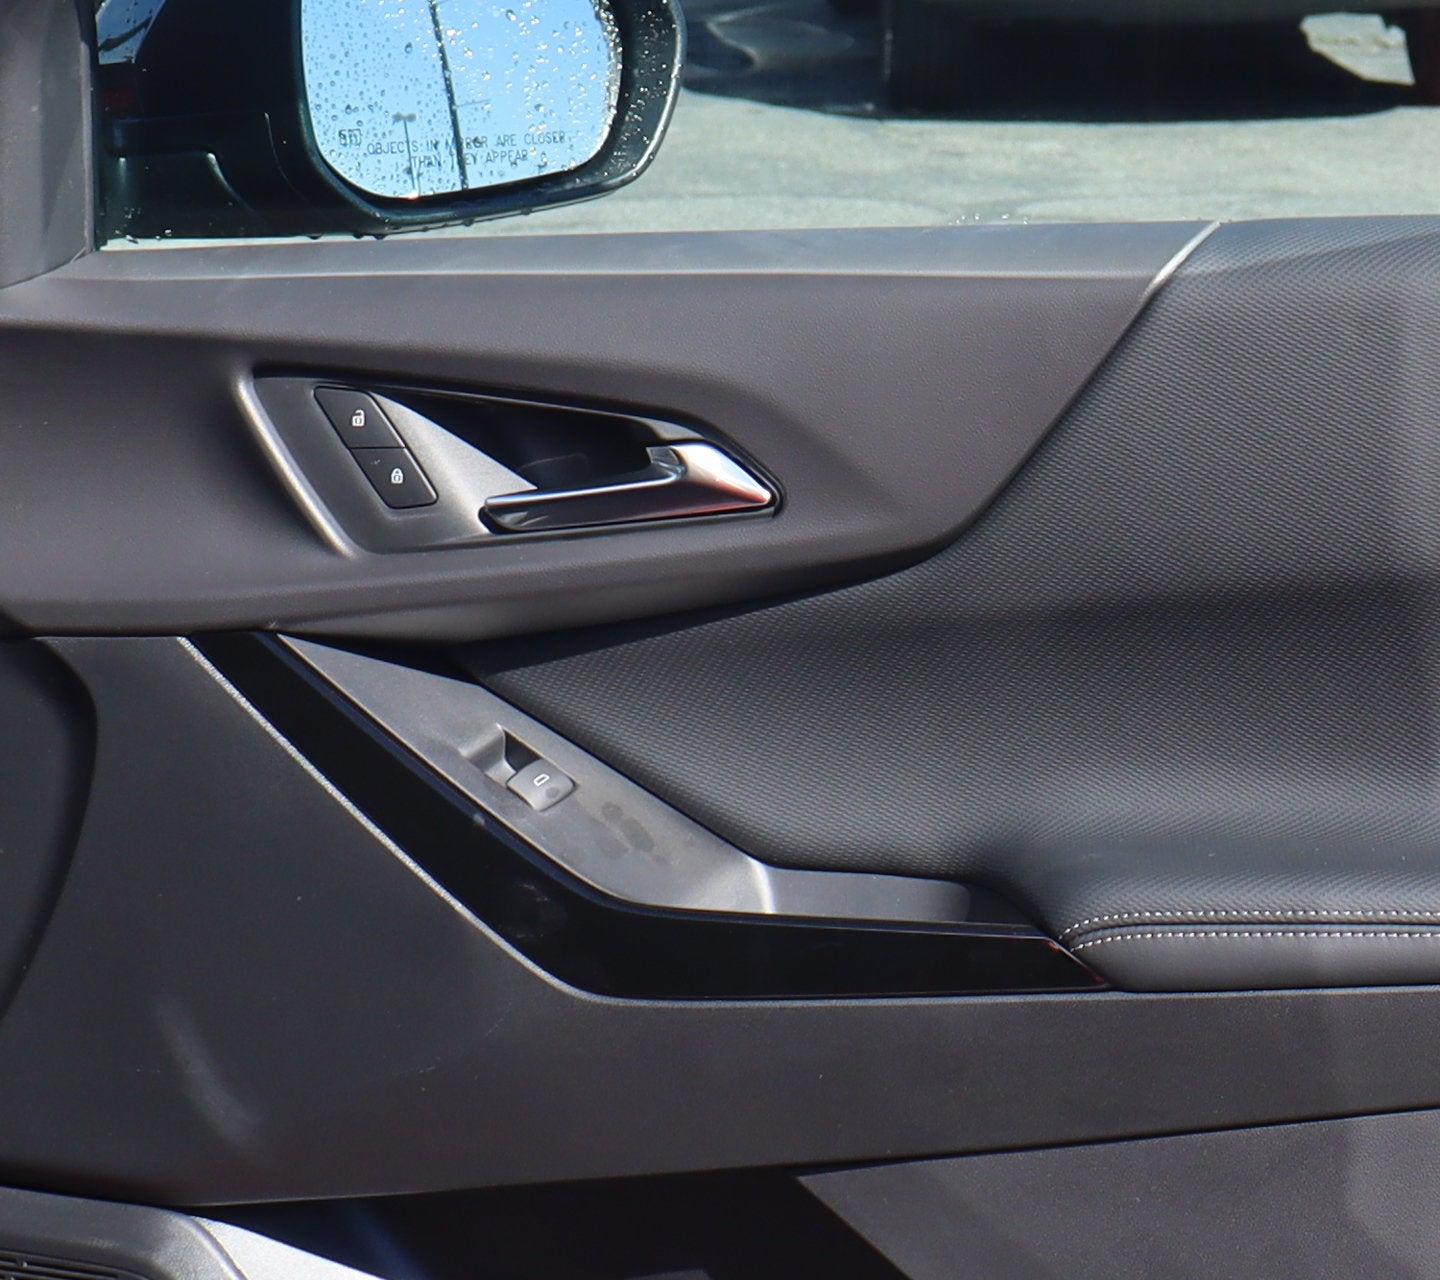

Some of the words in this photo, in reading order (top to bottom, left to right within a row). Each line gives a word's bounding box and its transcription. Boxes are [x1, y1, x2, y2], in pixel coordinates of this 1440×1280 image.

[366, 140, 419, 156] OBJECTS
[495, 133, 518, 148] ARE
[523, 131, 567, 145] CLOSER
[485, 149, 530, 166] APPEAR
